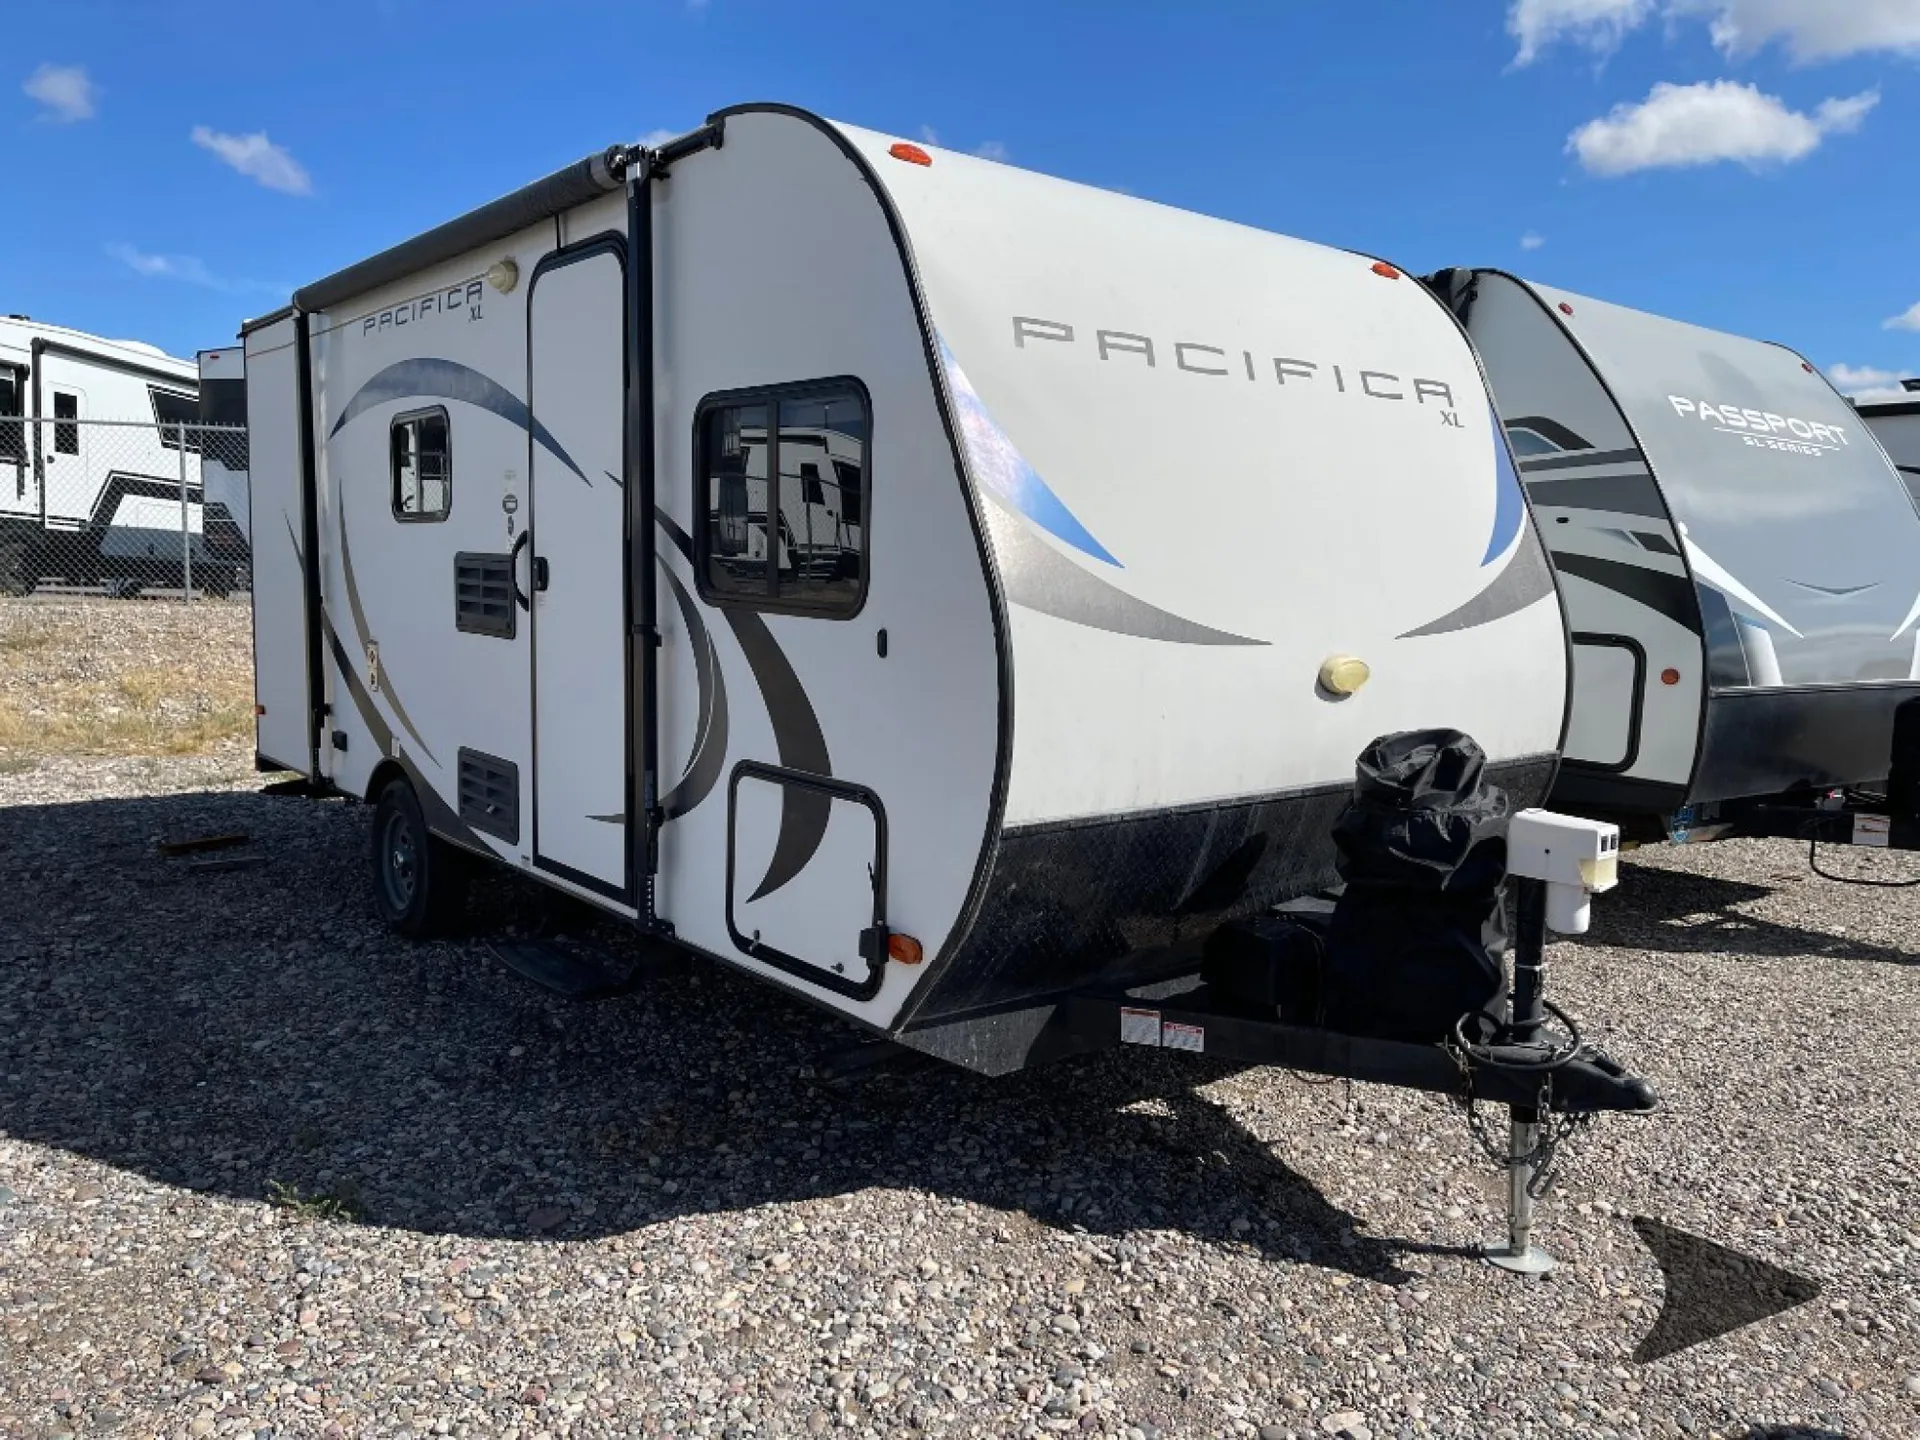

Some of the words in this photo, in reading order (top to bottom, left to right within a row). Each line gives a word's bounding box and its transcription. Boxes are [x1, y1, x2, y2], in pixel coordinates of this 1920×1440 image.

[363, 281, 483, 337] PACIFICA
[468, 304, 484, 323] XL
[1012, 316, 1455, 408] PACIFICA
[1439, 410, 1465, 429] XL
[1668, 394, 1849, 446] PASSPORT
[1742, 436, 1765, 448] SL
[1766, 440, 1822, 457] SERIES
